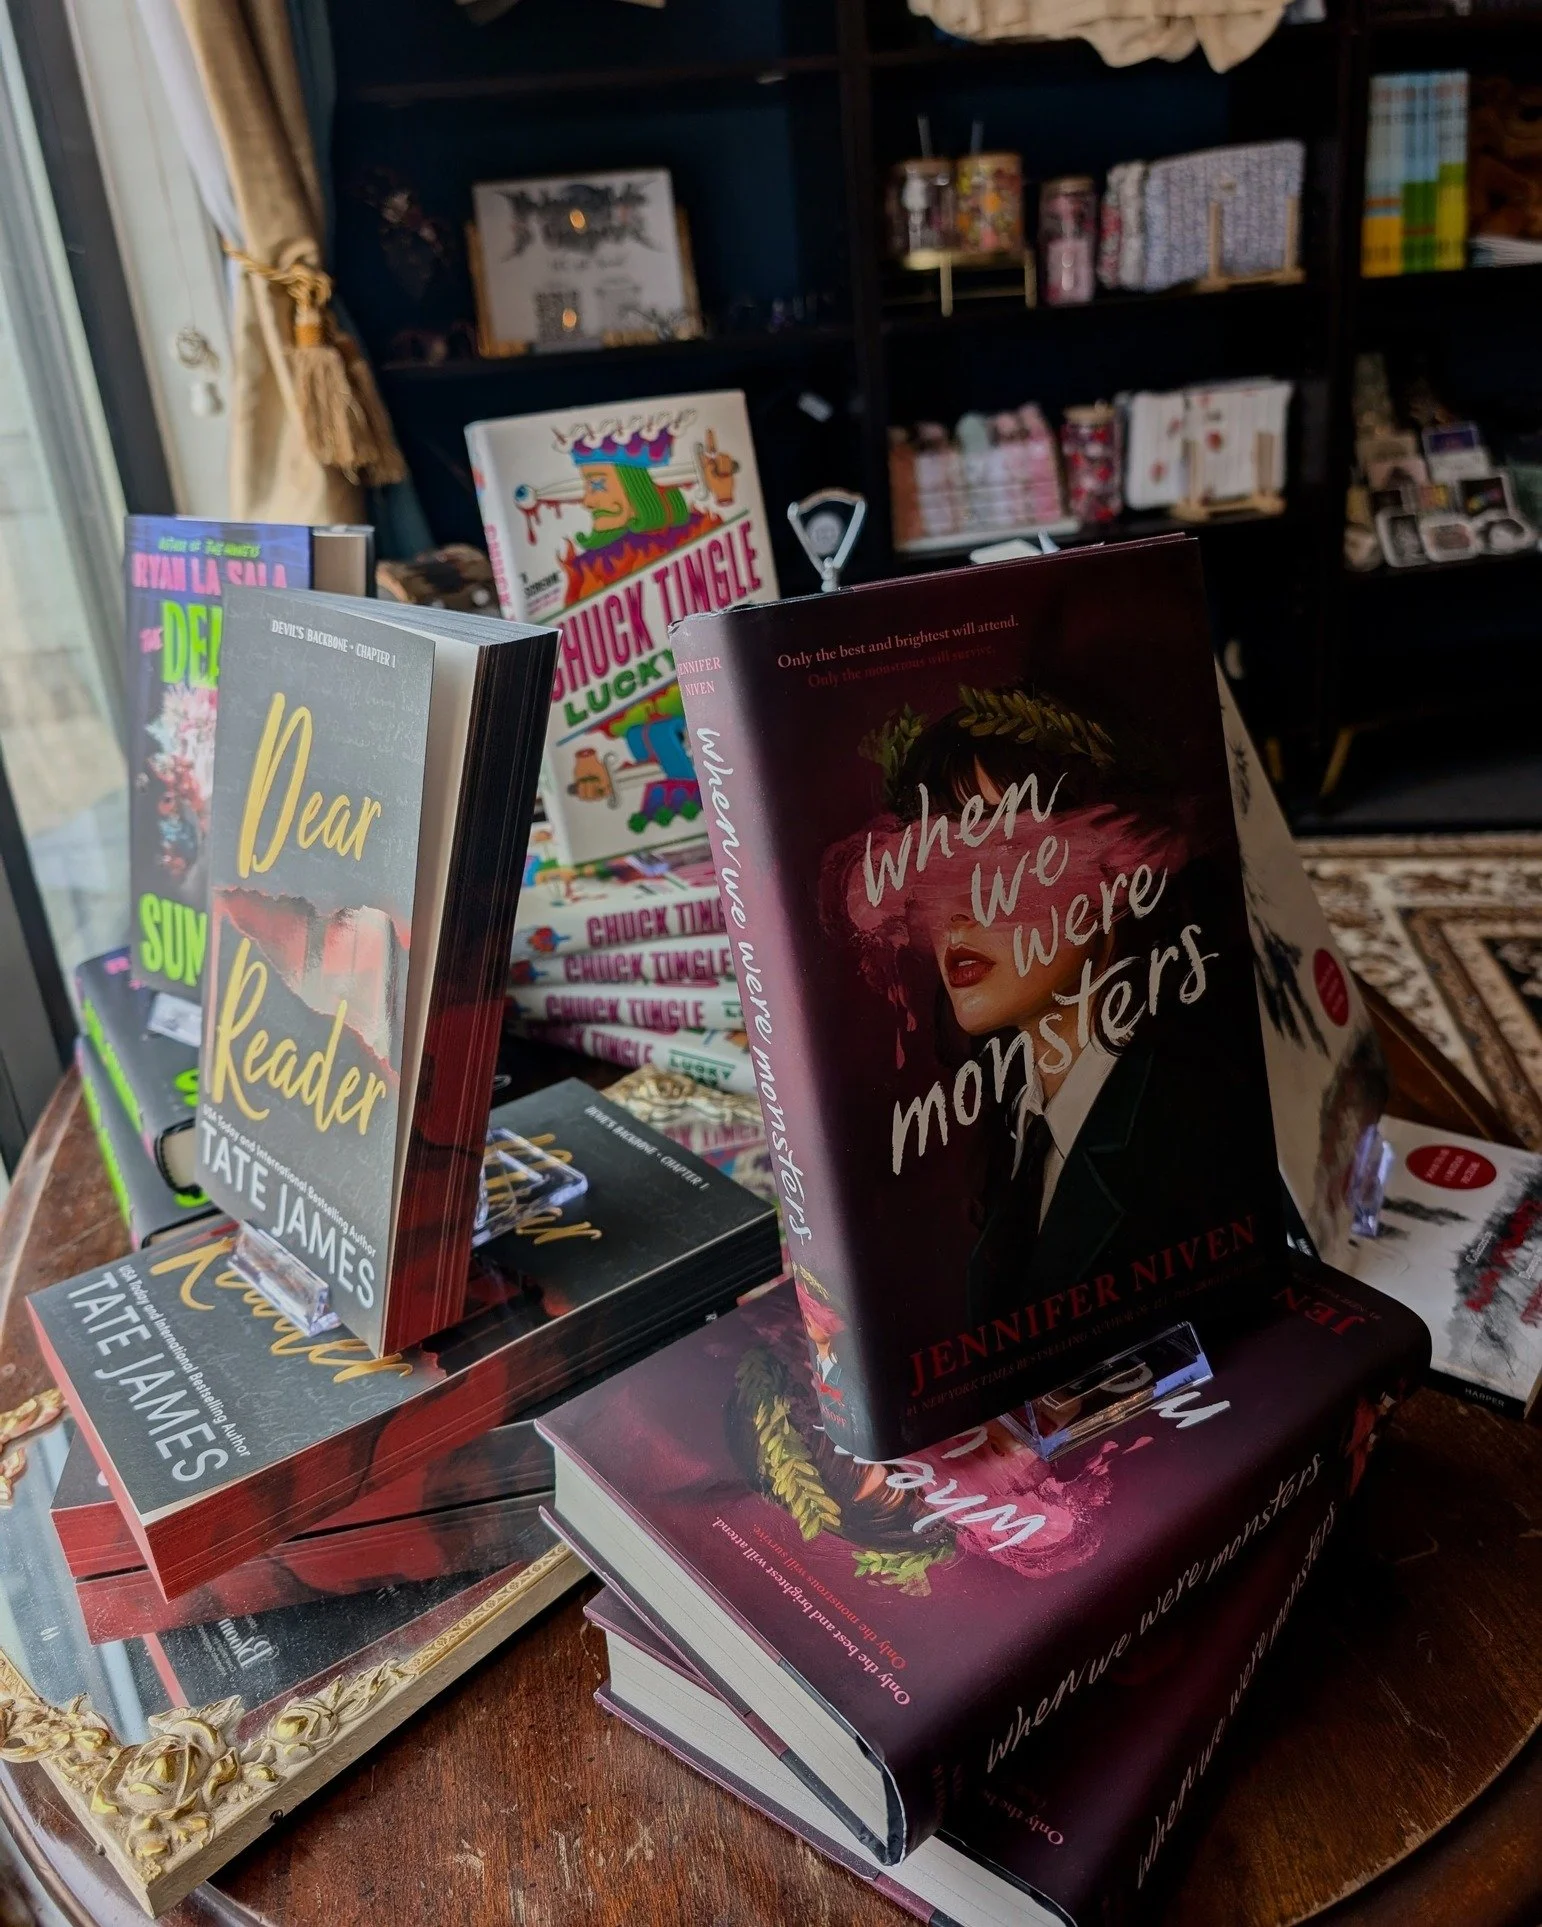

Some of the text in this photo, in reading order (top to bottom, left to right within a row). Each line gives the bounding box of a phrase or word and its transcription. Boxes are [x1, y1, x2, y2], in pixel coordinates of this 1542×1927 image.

[131, 552, 187, 592] RYAN
[189, 555, 222, 597] LA
[654, 518, 763, 627] TINGLE
[272, 619, 305, 640] DEVIL'S
[306, 628, 349, 653] BACKBONE
[355, 643, 391, 667] CHAPTER
[684, 680, 716, 697] NIVEN
[777, 614, 1019, 669] Only the best and brightest will attend.
[808, 671, 839, 688] Only
[842, 666, 862, 682] the
[239, 692, 381, 879] Dear
[863, 771, 1069, 908] when
[586, 905, 670, 948] CHUCK
[970, 834, 1070, 928] we
[1012, 862, 1168, 978] were
[545, 994, 704, 1029] CHUCK TINGLE
[563, 948, 732, 986] CHUCK TINGLE
[696, 727, 814, 1247] when we were monsters
[211, 937, 387, 1136] Reader
[669, 1053, 733, 1081] LUCKY
[892, 923, 1220, 1176] monsters
[201, 1119, 269, 1212] TATE
[271, 1182, 376, 1310] JAMES
[202, 1103, 377, 1258] USA Today and International Bestselling Author
[660, 1154, 704, 1188] CHAPTER
[66, 1271, 152, 1357] TATE
[118, 1264, 251, 1458] USA Today and International Bestselling Author
[906, 1272, 1123, 1399] JENNIFER
[1129, 1211, 1259, 1294] NIVEN
[93, 1352, 230, 1483] JAMES
[711, 1516, 911, 1705] Only the best and brightest will attend.
[753, 1523, 907, 1671] Only the monstrous will survive.
[985, 1452, 1324, 1775] when we were monsters
[1137, 1500, 1337, 1891] when we were monsters
[1025, 1814, 1064, 1845] Only
